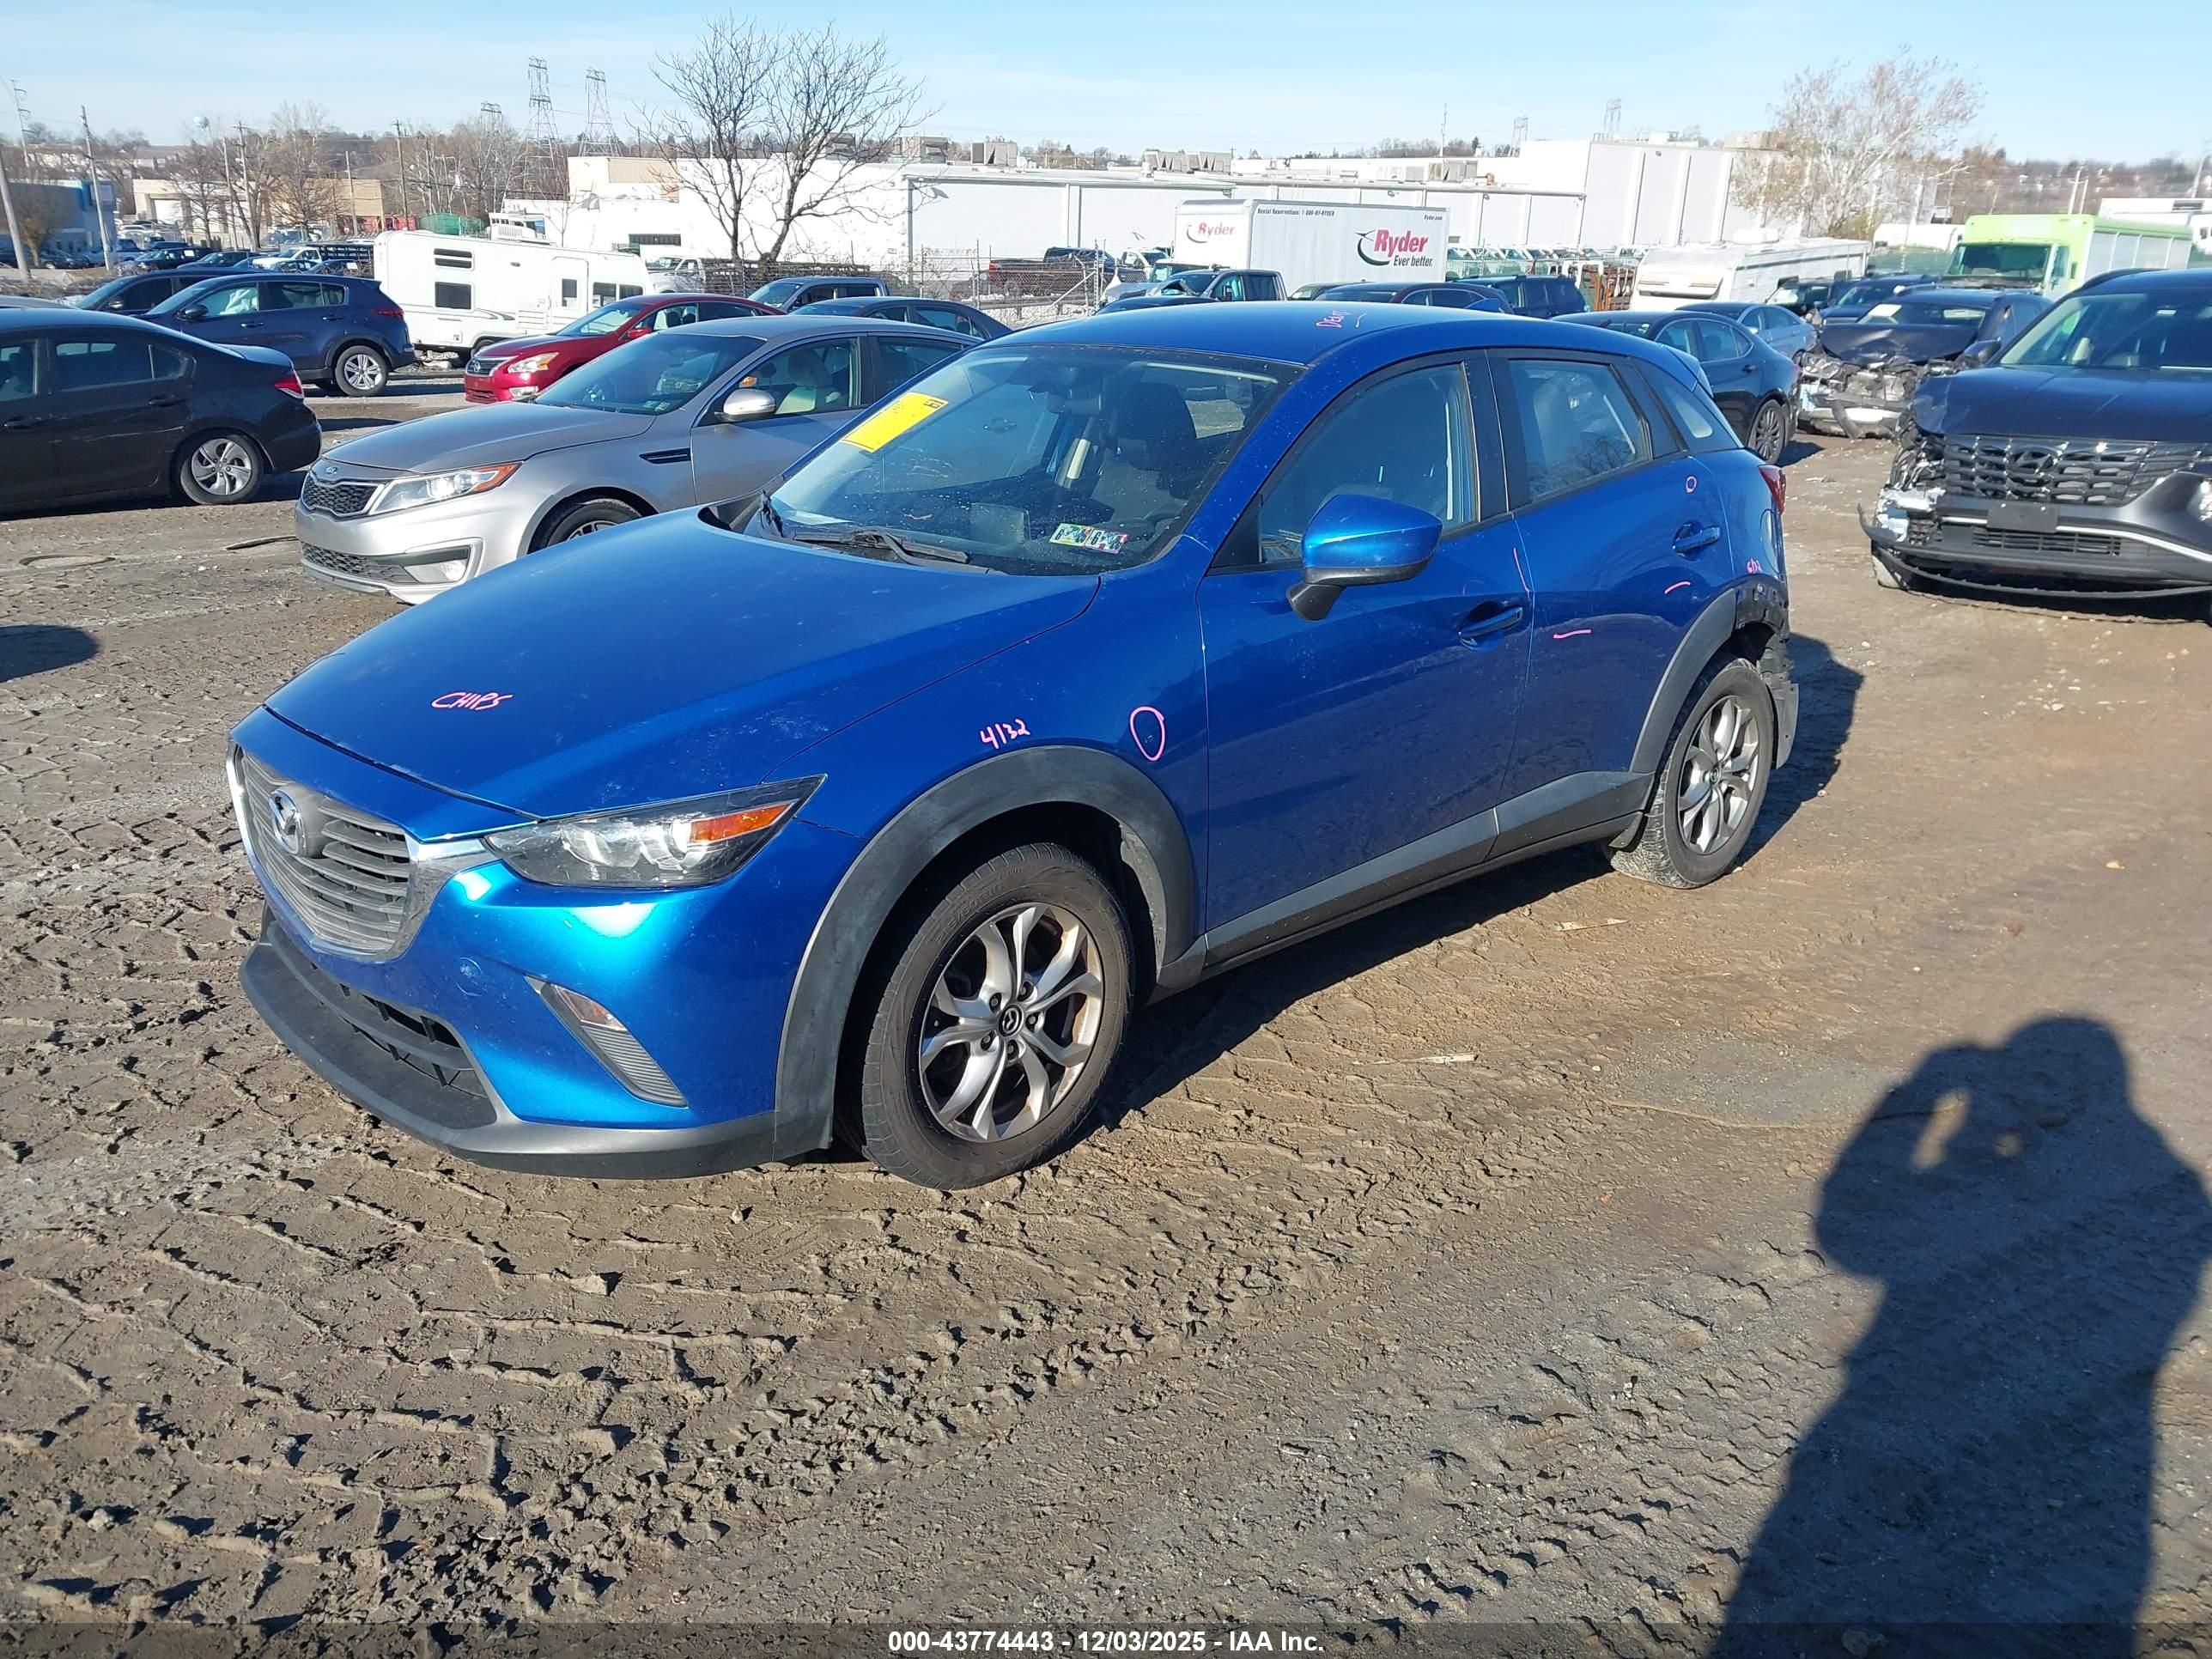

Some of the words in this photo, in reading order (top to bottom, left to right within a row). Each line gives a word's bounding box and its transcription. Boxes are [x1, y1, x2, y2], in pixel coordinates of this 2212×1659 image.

[1198, 222, 1236, 239] Ryder
[1374, 229, 1429, 257] Ryder
[1393, 254, 1410, 266] Ever
[1411, 255, 1434, 266] better.
[431, 692, 514, 711] CHIPS
